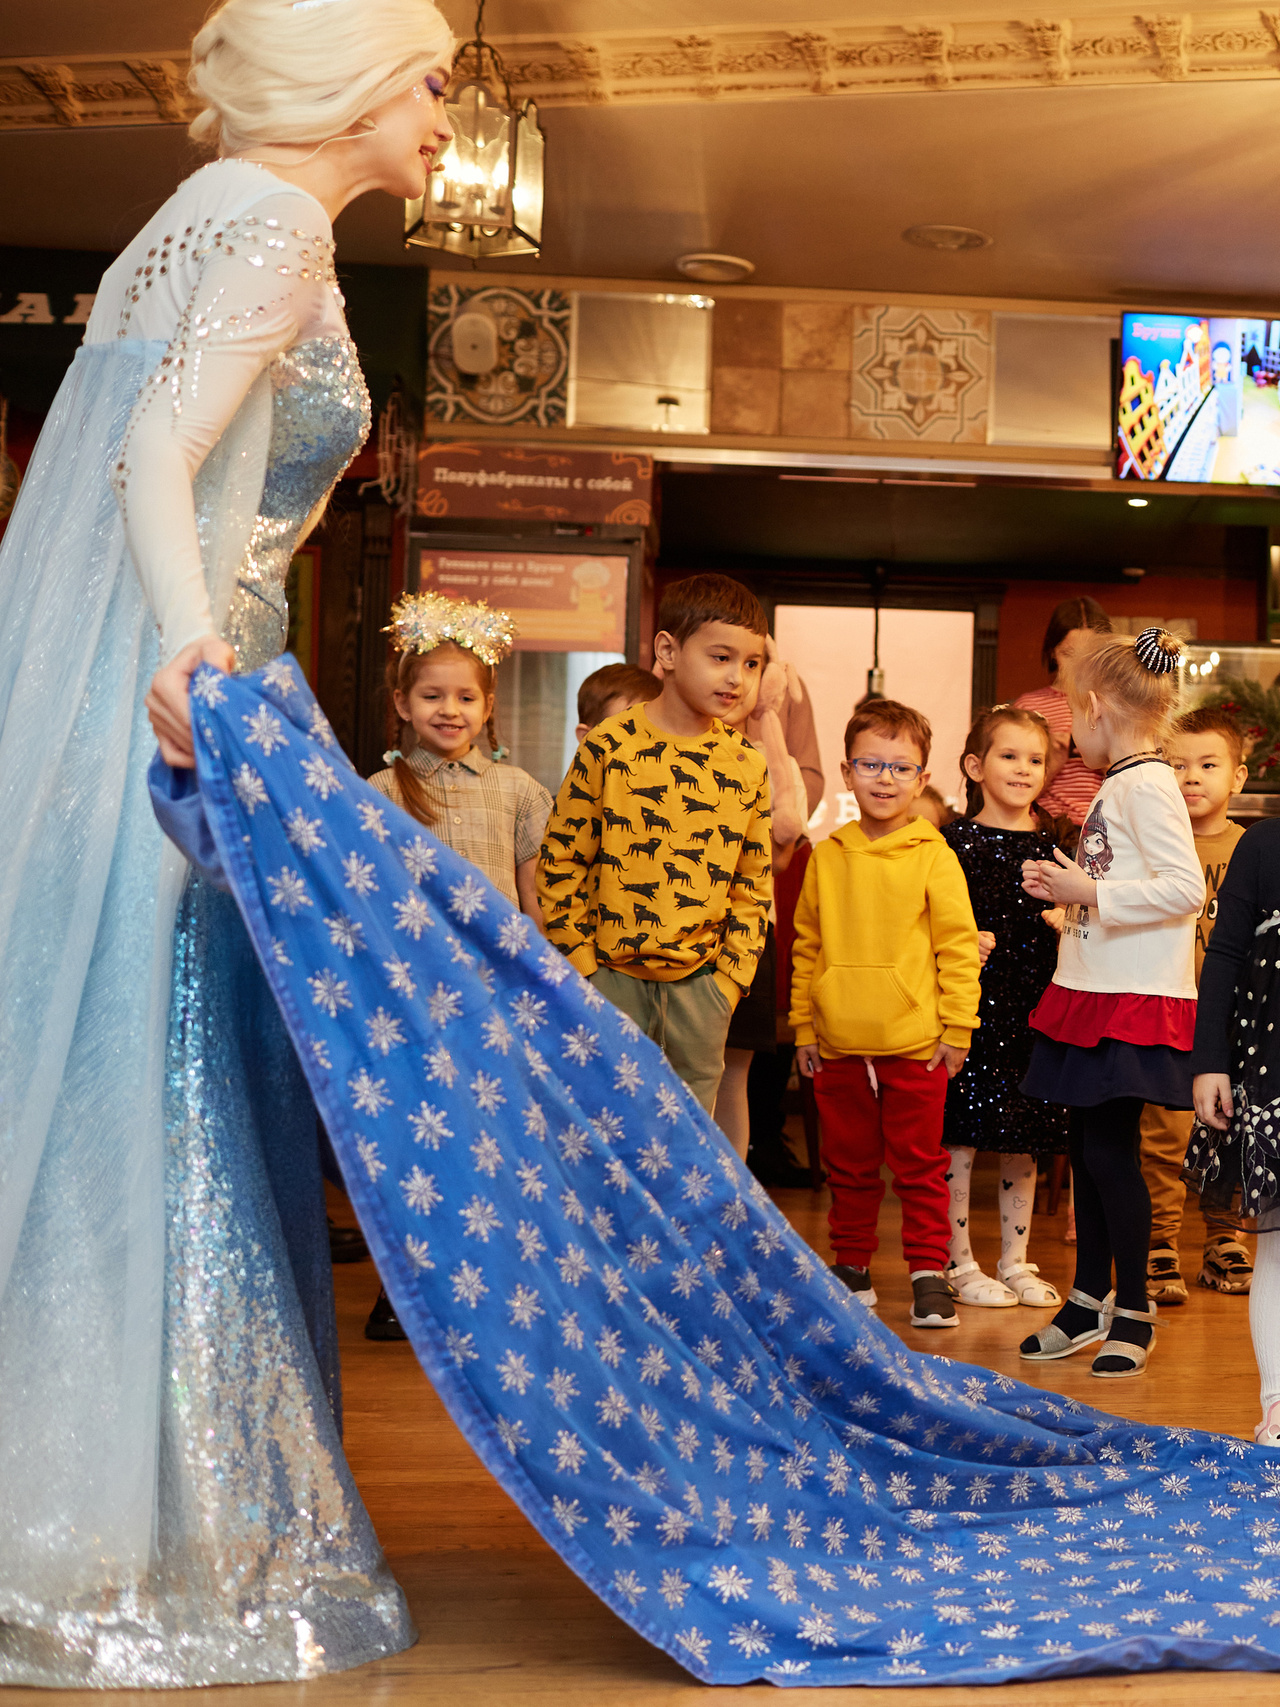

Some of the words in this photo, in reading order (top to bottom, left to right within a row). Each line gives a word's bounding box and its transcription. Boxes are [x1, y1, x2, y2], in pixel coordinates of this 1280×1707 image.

[434, 467, 570, 488] Полуфабрикаты
[573, 477, 583, 489] с
[587, 476, 633, 492] собой
